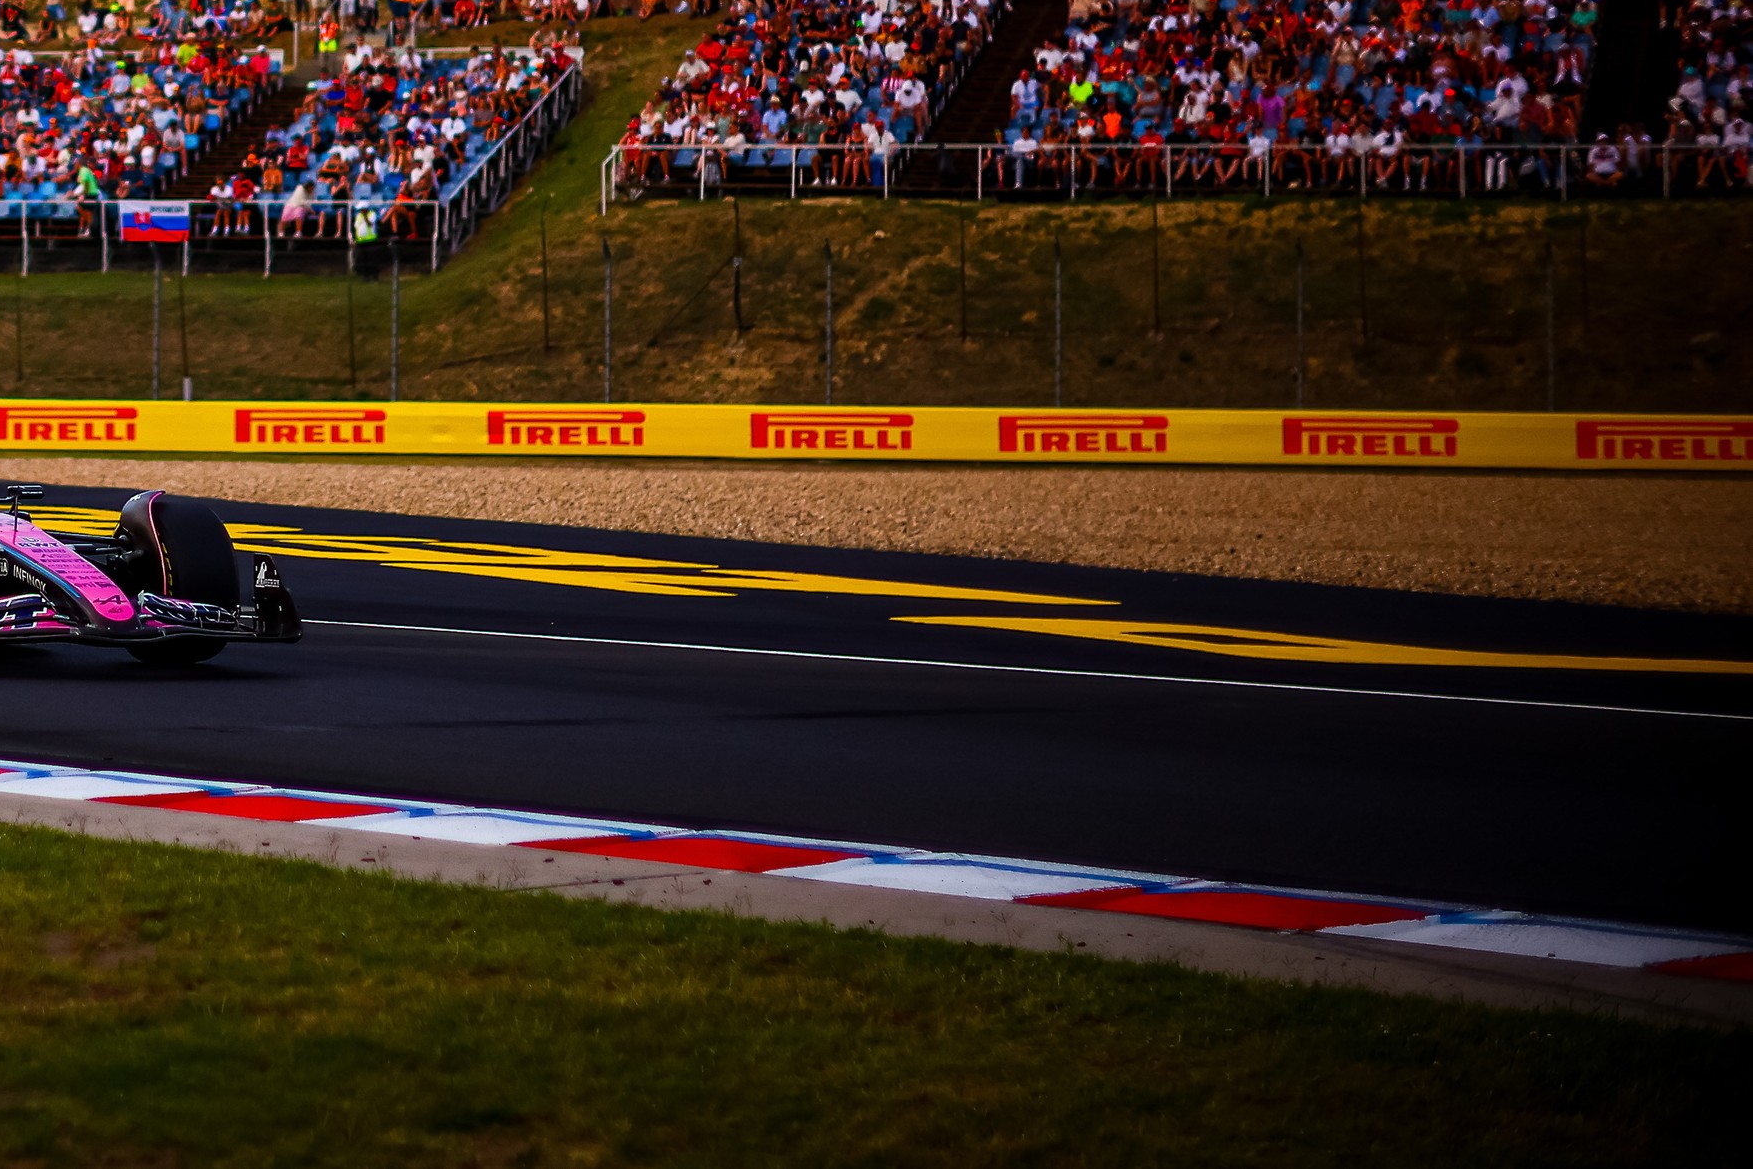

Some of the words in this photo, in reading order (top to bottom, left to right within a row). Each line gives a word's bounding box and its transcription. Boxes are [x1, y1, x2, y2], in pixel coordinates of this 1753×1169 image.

[235, 409, 386, 444] PIRELLI
[487, 411, 646, 447] PIRELLI
[750, 413, 914, 450] PIRELLI
[998, 416, 1169, 453] PIRELLI
[1282, 418, 1459, 457] PIRELLI
[1576, 421, 1753, 461] PIRELLI
